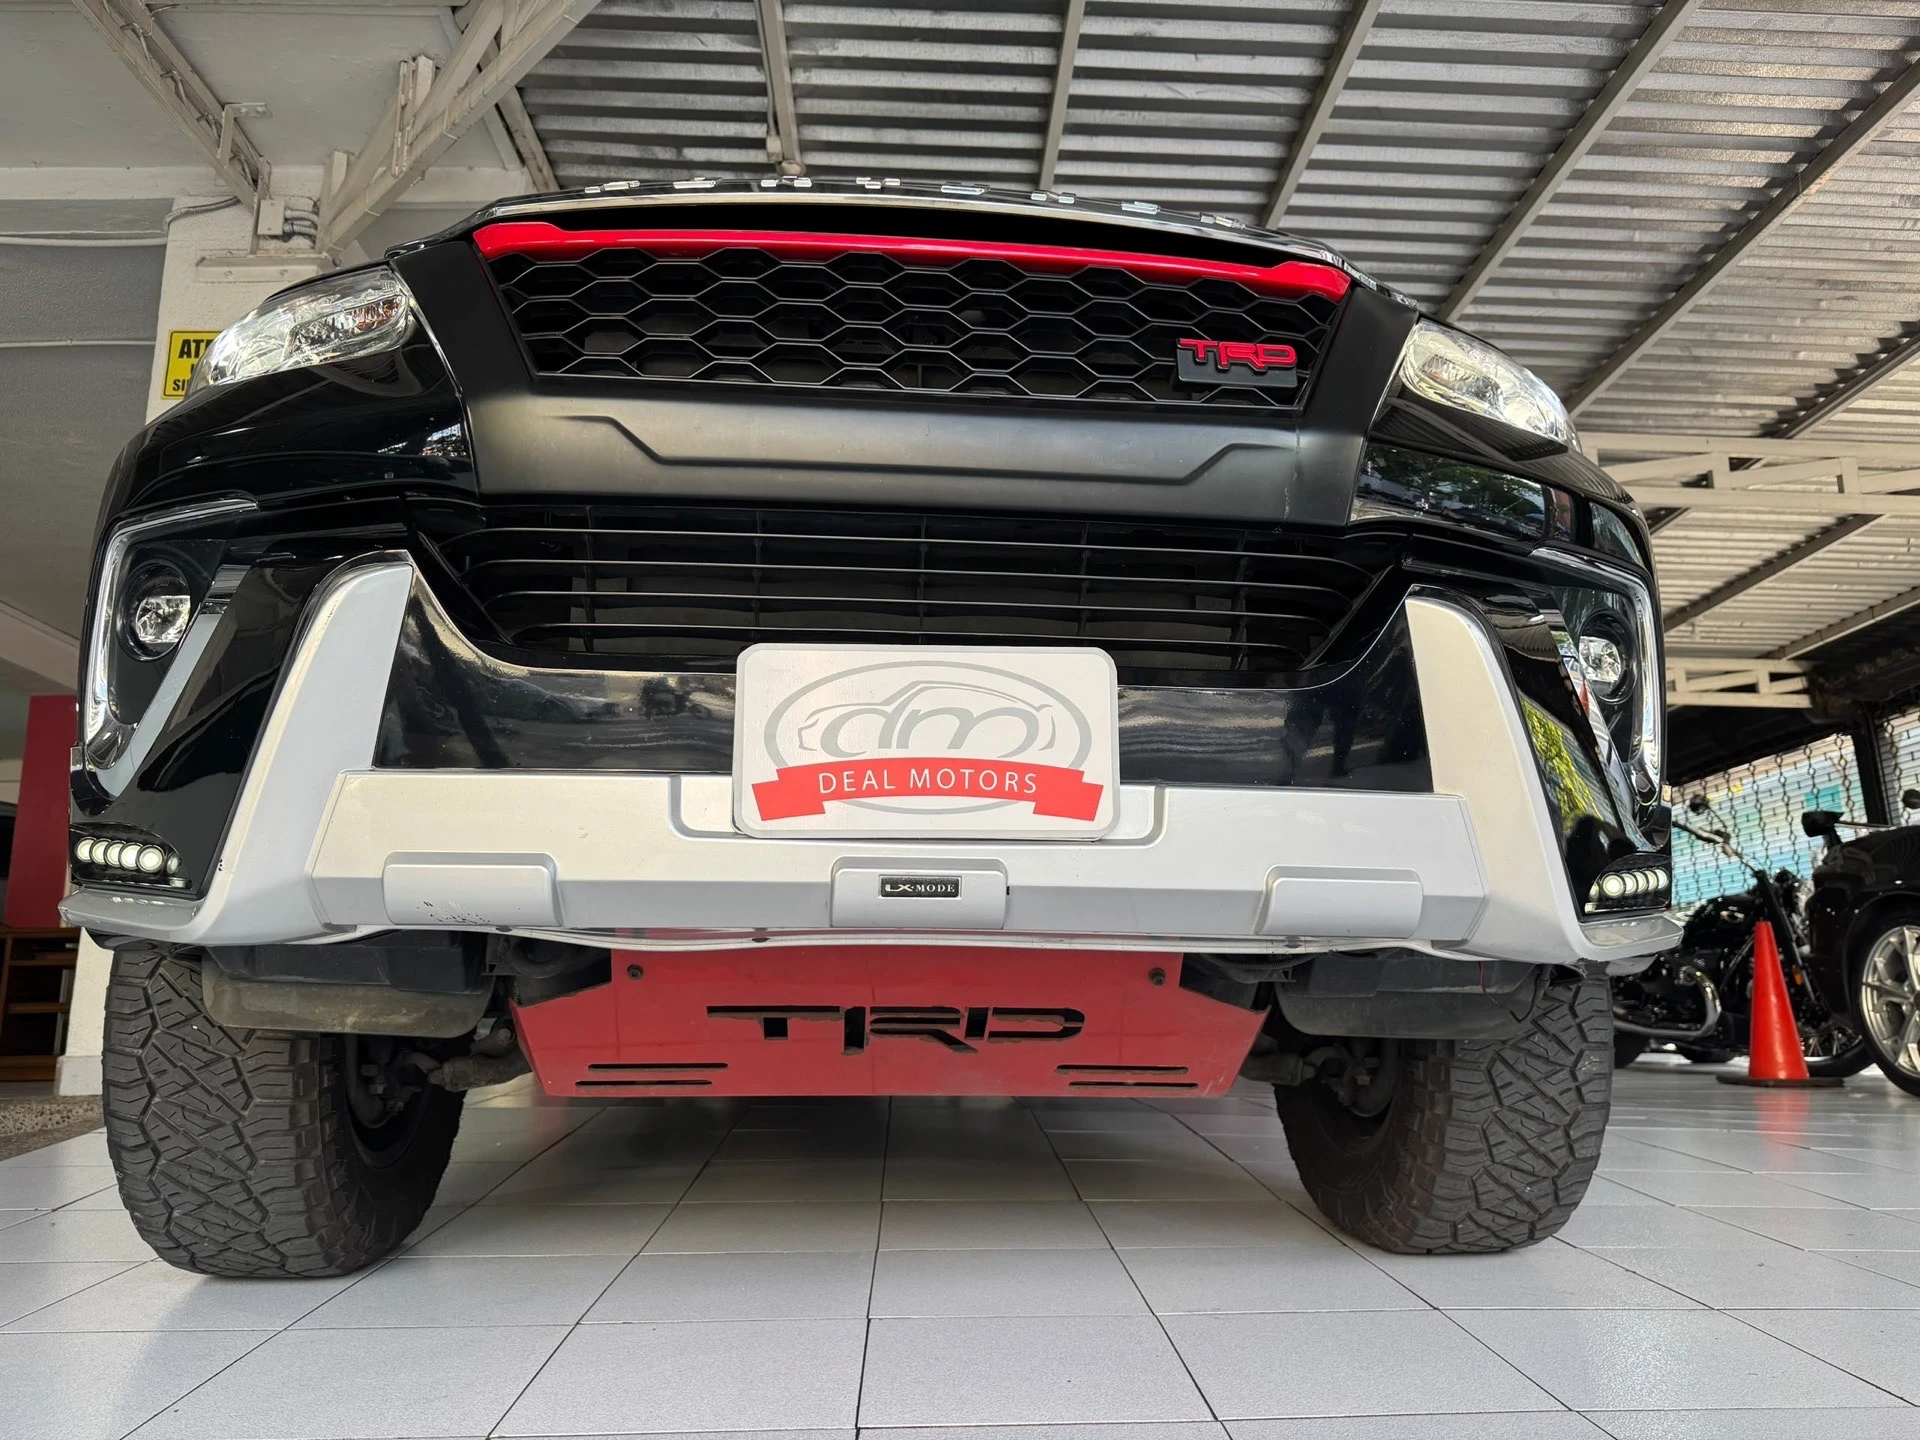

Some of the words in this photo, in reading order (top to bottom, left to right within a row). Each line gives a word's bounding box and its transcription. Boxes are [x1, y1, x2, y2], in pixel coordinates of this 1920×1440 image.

[1178, 338, 1297, 371] TRD
[818, 769, 896, 794] DEAL
[909, 768, 1037, 794] MOTORS
[706, 1005, 1085, 1055] TRD
